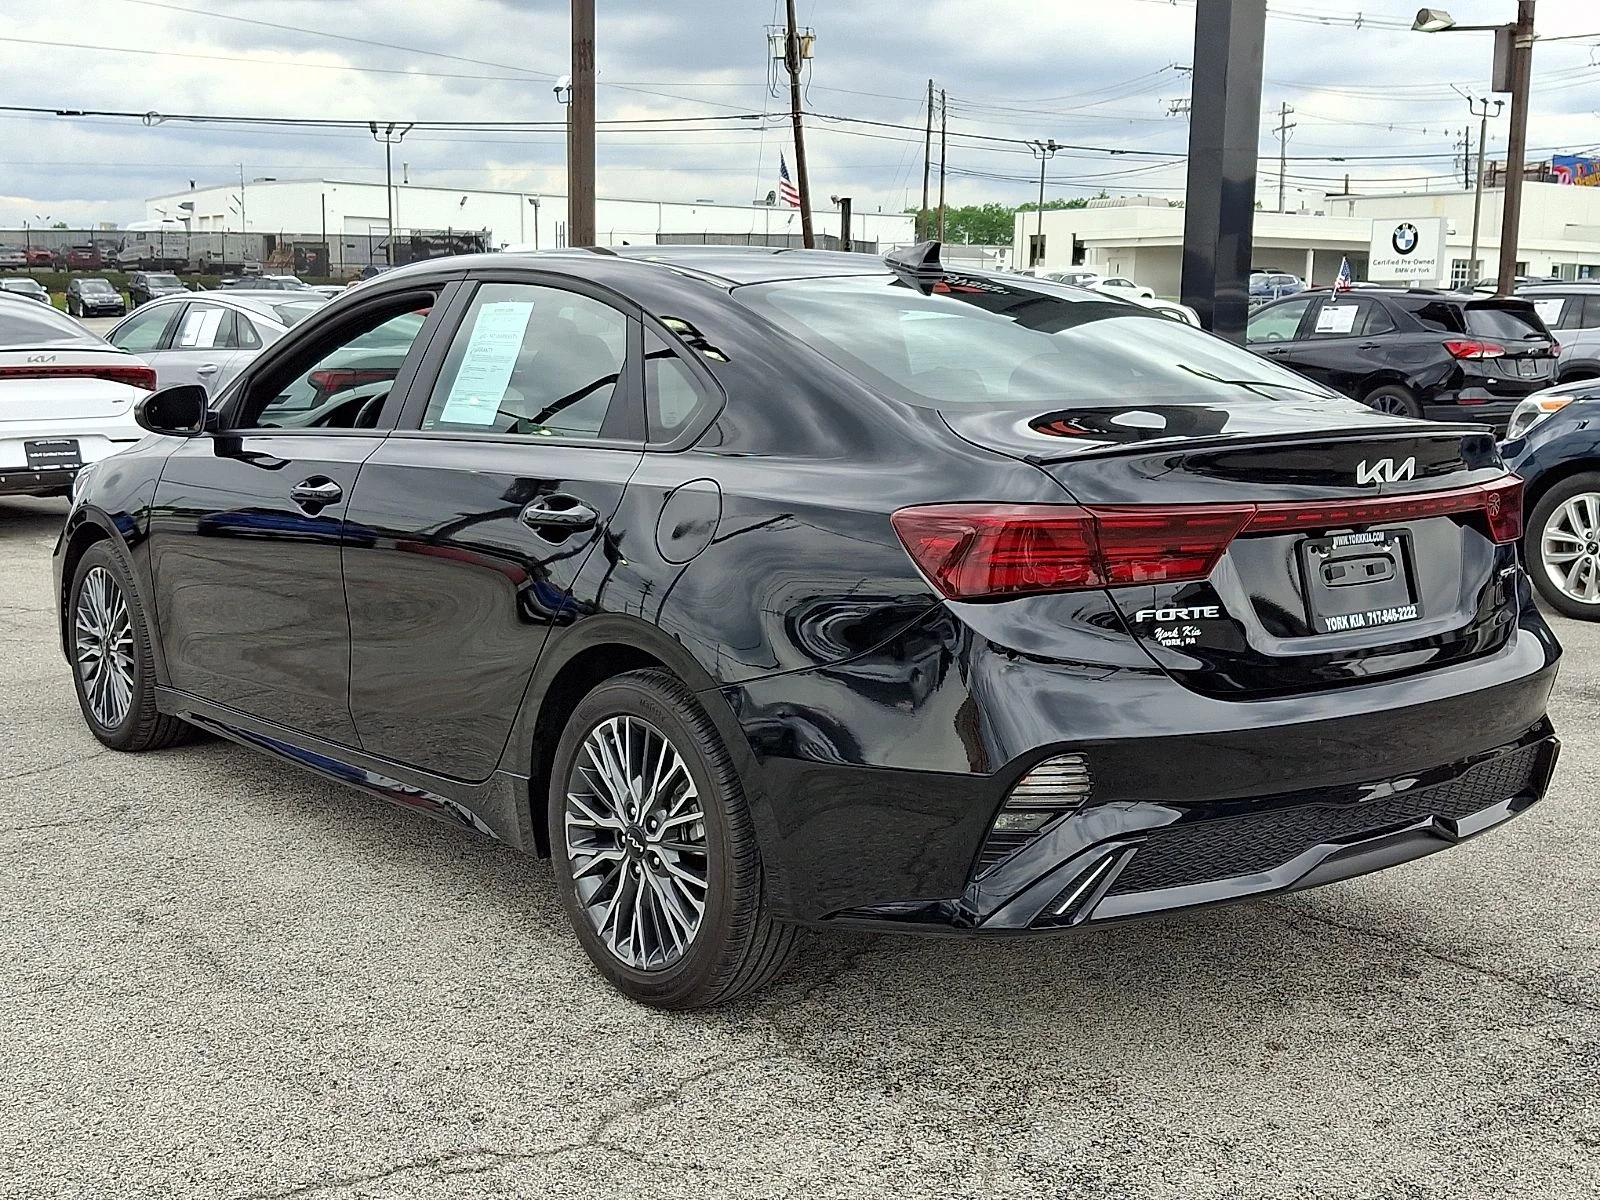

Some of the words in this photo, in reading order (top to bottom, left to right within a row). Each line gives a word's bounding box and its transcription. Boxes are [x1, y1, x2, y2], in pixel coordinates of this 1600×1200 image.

[27, 355, 56, 363] KIA
[1357, 456, 1416, 485] KIA
[1332, 531, 1385, 547] WWW.YORKKIA.COM
[1135, 606, 1220, 623] FORTE
[1325, 615, 1350, 631] YORK
[1350, 613, 1366, 628] KIA
[1367, 606, 1417, 626] 717-846-2222
[1154, 627, 1179, 642] York
[1182, 626, 1202, 637] Kia
[1161, 638, 1184, 647] YORK,
[1185, 637, 1196, 645] PA
